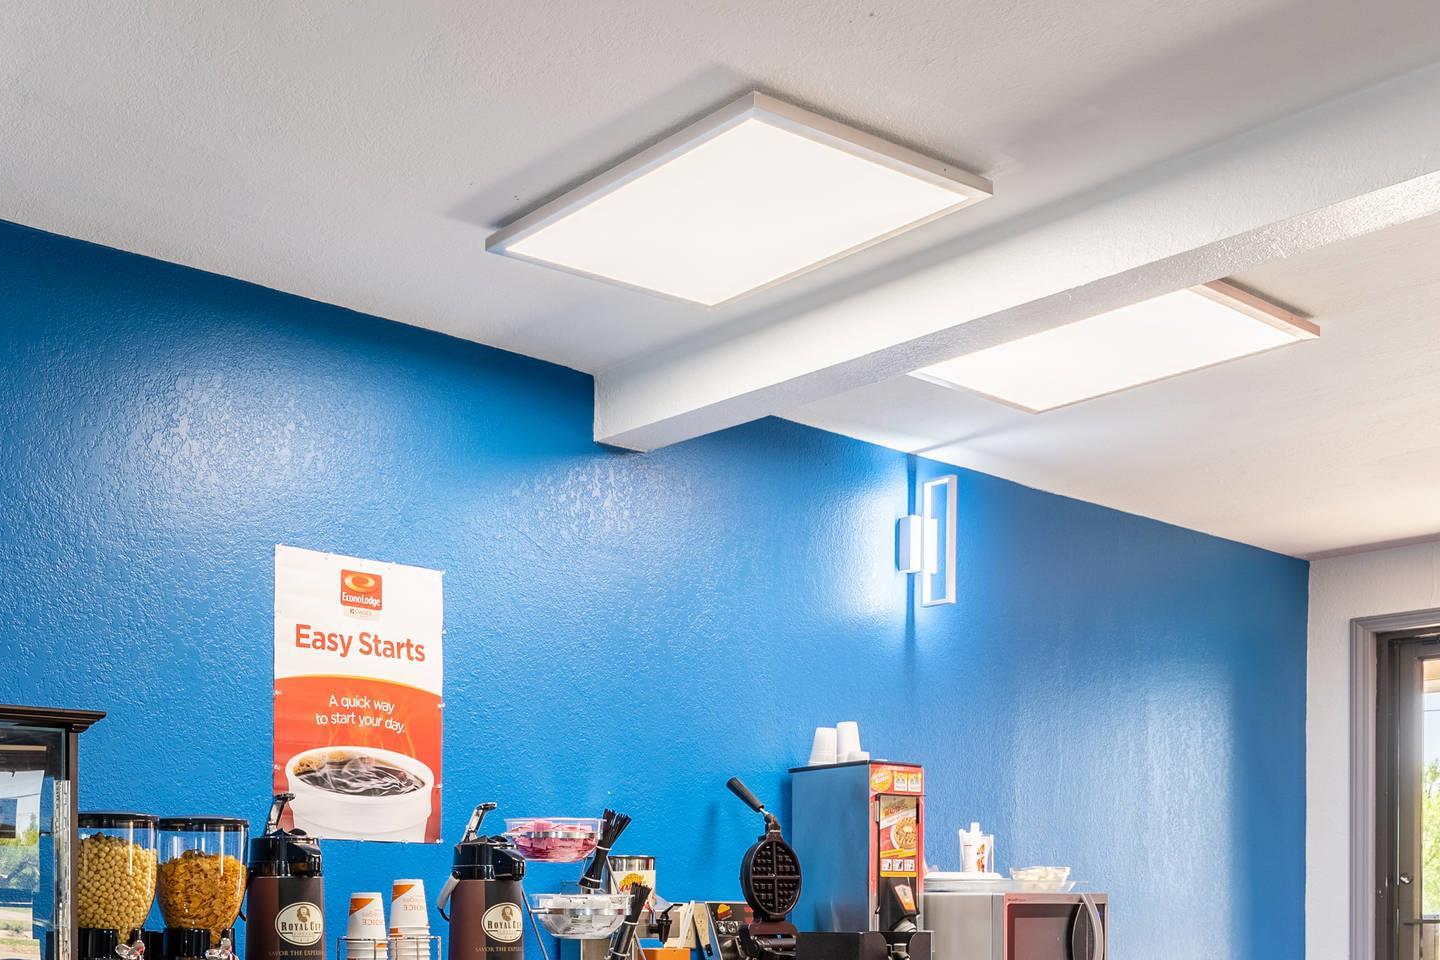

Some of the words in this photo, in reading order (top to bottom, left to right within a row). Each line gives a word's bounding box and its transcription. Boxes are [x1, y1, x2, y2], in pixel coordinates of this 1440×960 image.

[295, 623, 353, 658] Easy
[358, 631, 426, 662] Starts
[328, 694, 339, 707] A
[341, 694, 371, 712] quick
[373, 699, 395, 714] way
[316, 713, 328, 725] to
[330, 712, 356, 726] start
[358, 714, 382, 729] your
[384, 716, 406, 734] day.
[281, 921, 308, 931] ROYAL
[487, 920, 512, 929] ROYAL
